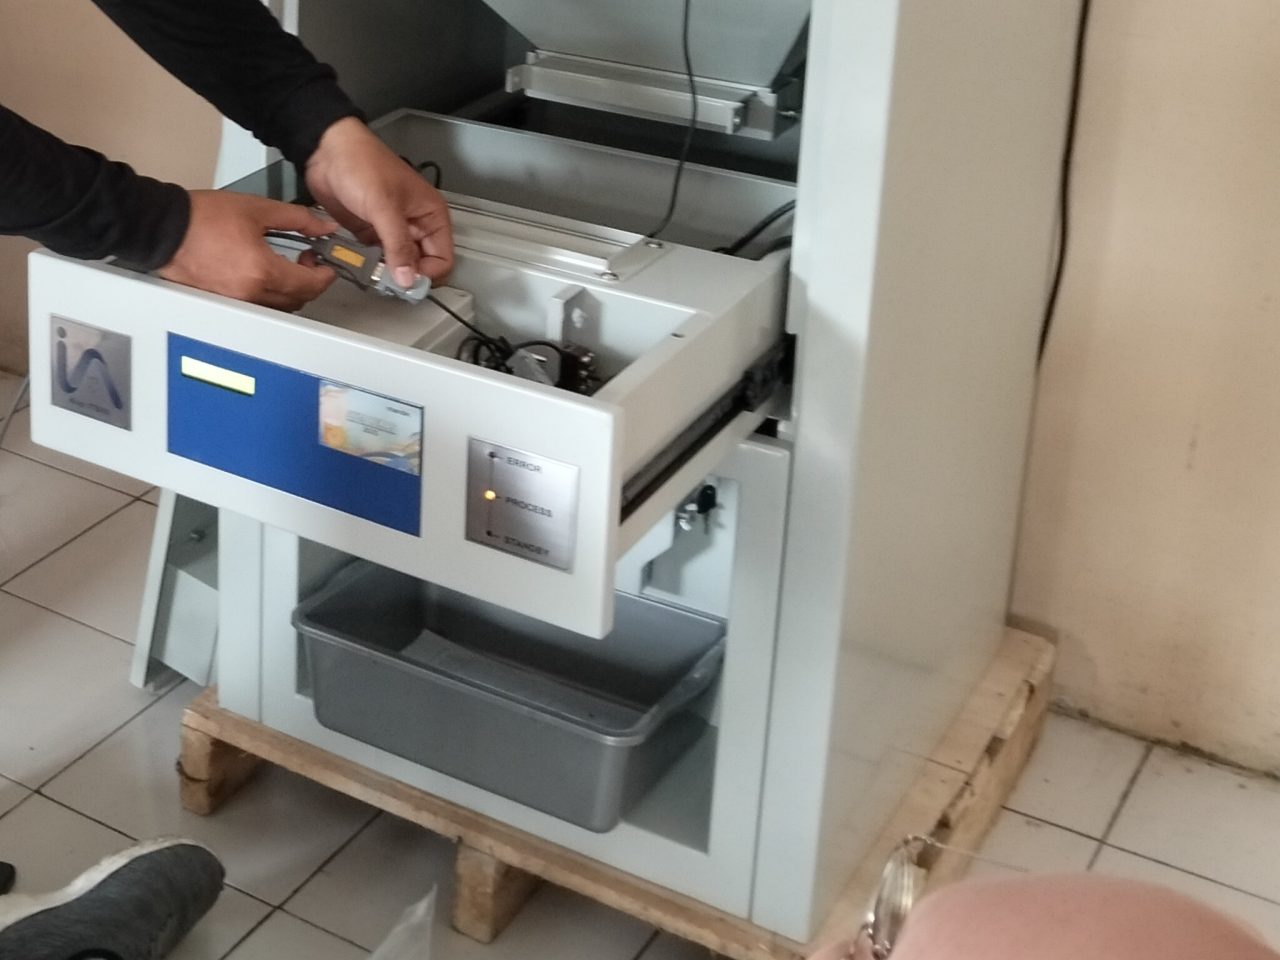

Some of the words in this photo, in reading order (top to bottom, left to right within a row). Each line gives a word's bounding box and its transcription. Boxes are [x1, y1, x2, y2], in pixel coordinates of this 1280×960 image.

[506, 456, 543, 473] ERROR
[505, 496, 553, 518] PROCESS
[503, 535, 550, 556] STANDBY
